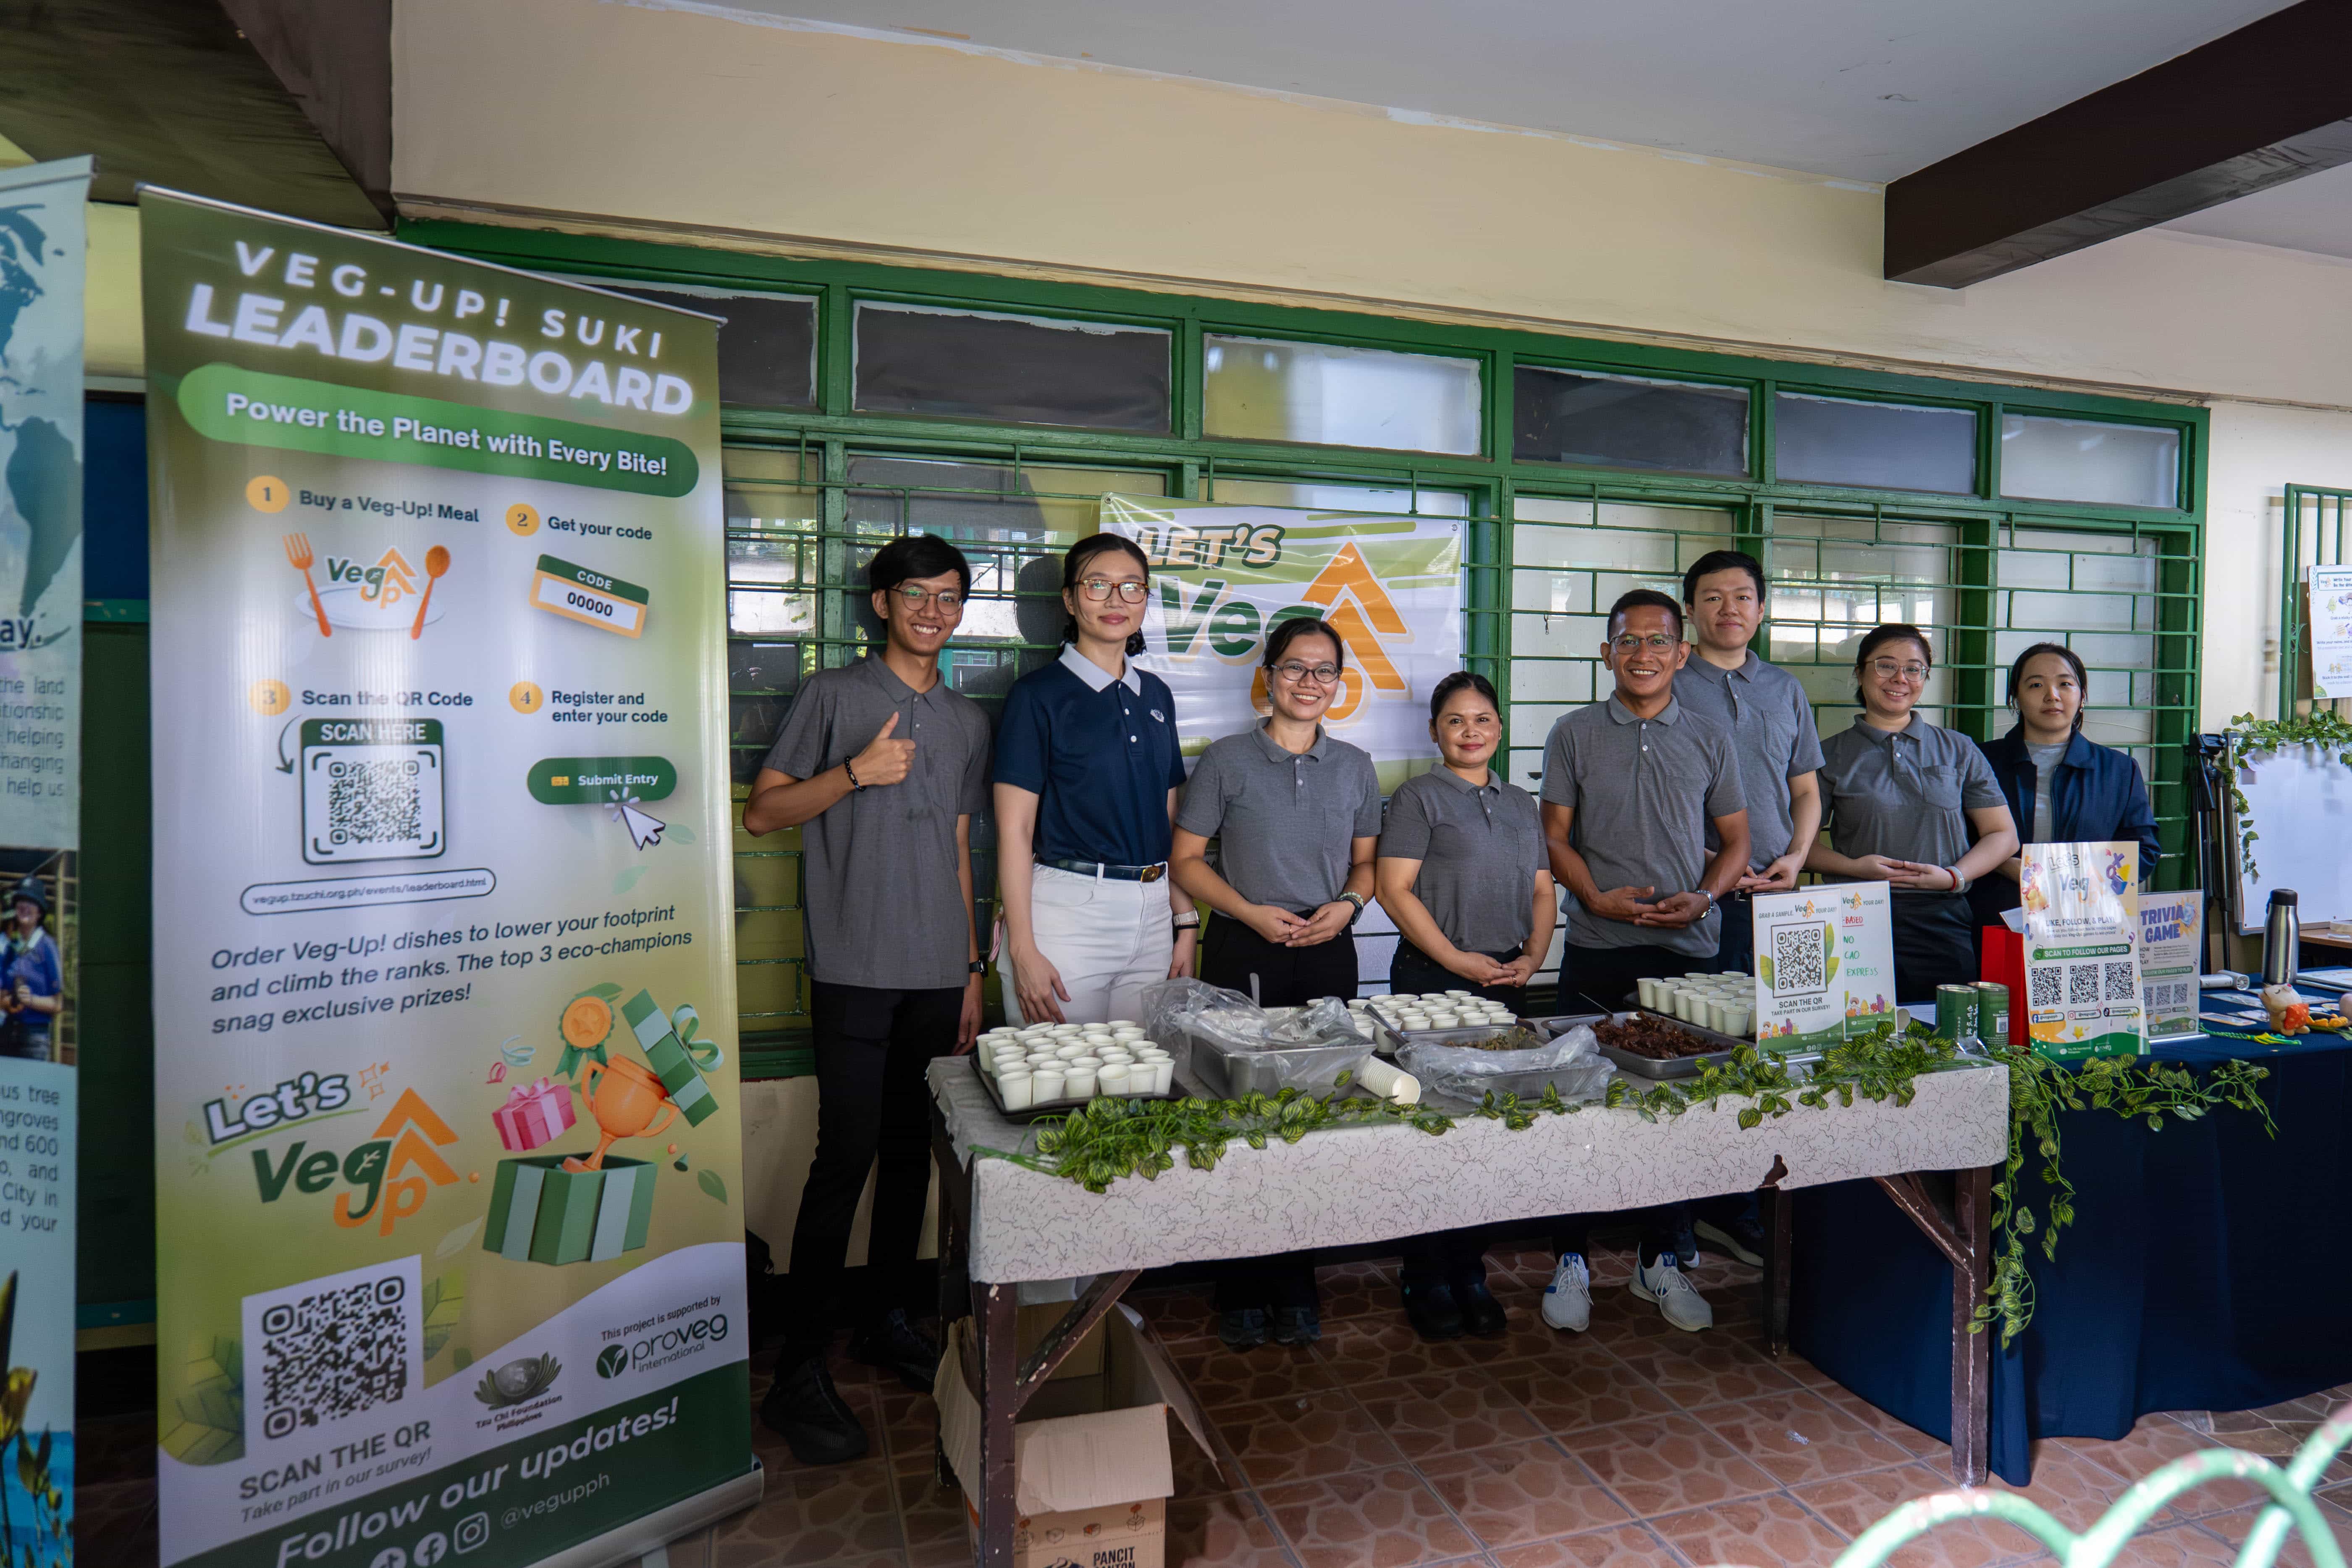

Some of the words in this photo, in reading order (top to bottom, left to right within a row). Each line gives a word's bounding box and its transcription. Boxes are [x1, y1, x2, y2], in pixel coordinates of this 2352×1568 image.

[235, 240, 510, 327] VEG-UP!
[541, 309, 661, 358] SUKI
[185, 283, 693, 415] LEADERBOARD
[226, 392, 329, 428] Power
[337, 409, 385, 436] the
[393, 417, 481, 450] Planet
[487, 433, 542, 458] with
[548, 439, 611, 472] Every
[617, 450, 667, 475] Bite!
[263, 486, 271, 501] 1
[299, 490, 336, 511] Buy
[341, 497, 353, 509] a
[357, 496, 433, 518] Veg-Up!
[438, 504, 480, 522] Meal
[517, 513, 528, 527] 2
[548, 516, 576, 531] Get
[579, 522, 612, 535] your
[616, 526, 653, 540] code
[1138, 523, 1286, 571] LET'S
[328, 558, 385, 598] Veg
[577, 570, 613, 590] CODE
[567, 592, 613, 616] 00000
[302, 690, 351, 705] Scan
[357, 690, 389, 705] the
[396, 692, 422, 706] QR
[427, 691, 474, 706] Code
[520, 691, 531, 704] 4
[552, 690, 614, 706] Register
[618, 692, 645, 705] and
[552, 709, 593, 722] enter
[596, 712, 628, 725] your
[631, 710, 669, 722] code
[7, 727, 64, 749] helping
[320, 723, 372, 742] SCAN
[378, 723, 427, 740] HERE
[7, 776, 42, 797] help
[48, 781, 64, 797] us
[578, 774, 622, 786] Submit
[624, 774, 658, 787] Entry
[253, 878, 486, 905] vegup.tzuchi.org.ph/events/leaderboard.html
[1795, 905, 1807, 916] Veg
[2140, 905, 2184, 926] TRIVIA
[211, 946, 286, 969] Order
[294, 934, 387, 962] Veg-Up!
[393, 929, 462, 951] dishes
[469, 924, 488, 941] to
[494, 921, 553, 939] lower
[556, 916, 599, 937] your
[603, 905, 676, 928] footprint
[1843, 935, 1854, 944] NO
[2145, 923, 2181, 943] GAME
[210, 978, 260, 1002] and
[266, 970, 333, 995] climb
[341, 967, 378, 986] the
[385, 959, 450, 981] ranks.
[457, 954, 493, 973] The
[500, 950, 533, 968] top
[540, 945, 552, 962] 3
[558, 930, 692, 960] eco-champions
[1847, 967, 1878, 977] EXPRESS
[211, 1011, 275, 1035] snag
[282, 996, 394, 1024] exclusive
[400, 983, 472, 1013] prizes!
[1779, 1000, 1798, 1008] SCAN
[29, 1085, 60, 1105] tree
[204, 1070, 350, 1145] Let's
[25, 1134, 58, 1156] 600
[28, 1163, 58, 1182] and
[252, 1140, 392, 1220] Veg
[3, 1181, 37, 1206] City
[45, 1191, 58, 1207] in
[21, 1214, 58, 1232] your
[601, 1328, 621, 1341] This
[623, 1317, 655, 1337] project
[657, 1314, 665, 1324] is
[667, 1296, 708, 1321] supported
[711, 1294, 721, 1306] by
[632, 1314, 728, 1370] proveg
[511, 1394, 562, 1416] Foundation
[239, 1453, 321, 1500] SCAN
[330, 1433, 386, 1469] THE
[393, 1420, 430, 1448] QR
[241, 1499, 283, 1523] Take
[287, 1484, 321, 1510] part
[326, 1478, 340, 1495] in
[345, 1470, 371, 1487] our
[376, 1446, 431, 1476] survey!
[276, 1493, 430, 1568] Follow
[439, 1464, 507, 1511] our
[520, 1396, 679, 1479] updates!
[500, 1471, 610, 1530] @vegupph
[1093, 1546, 1135, 1566] PANCIT
